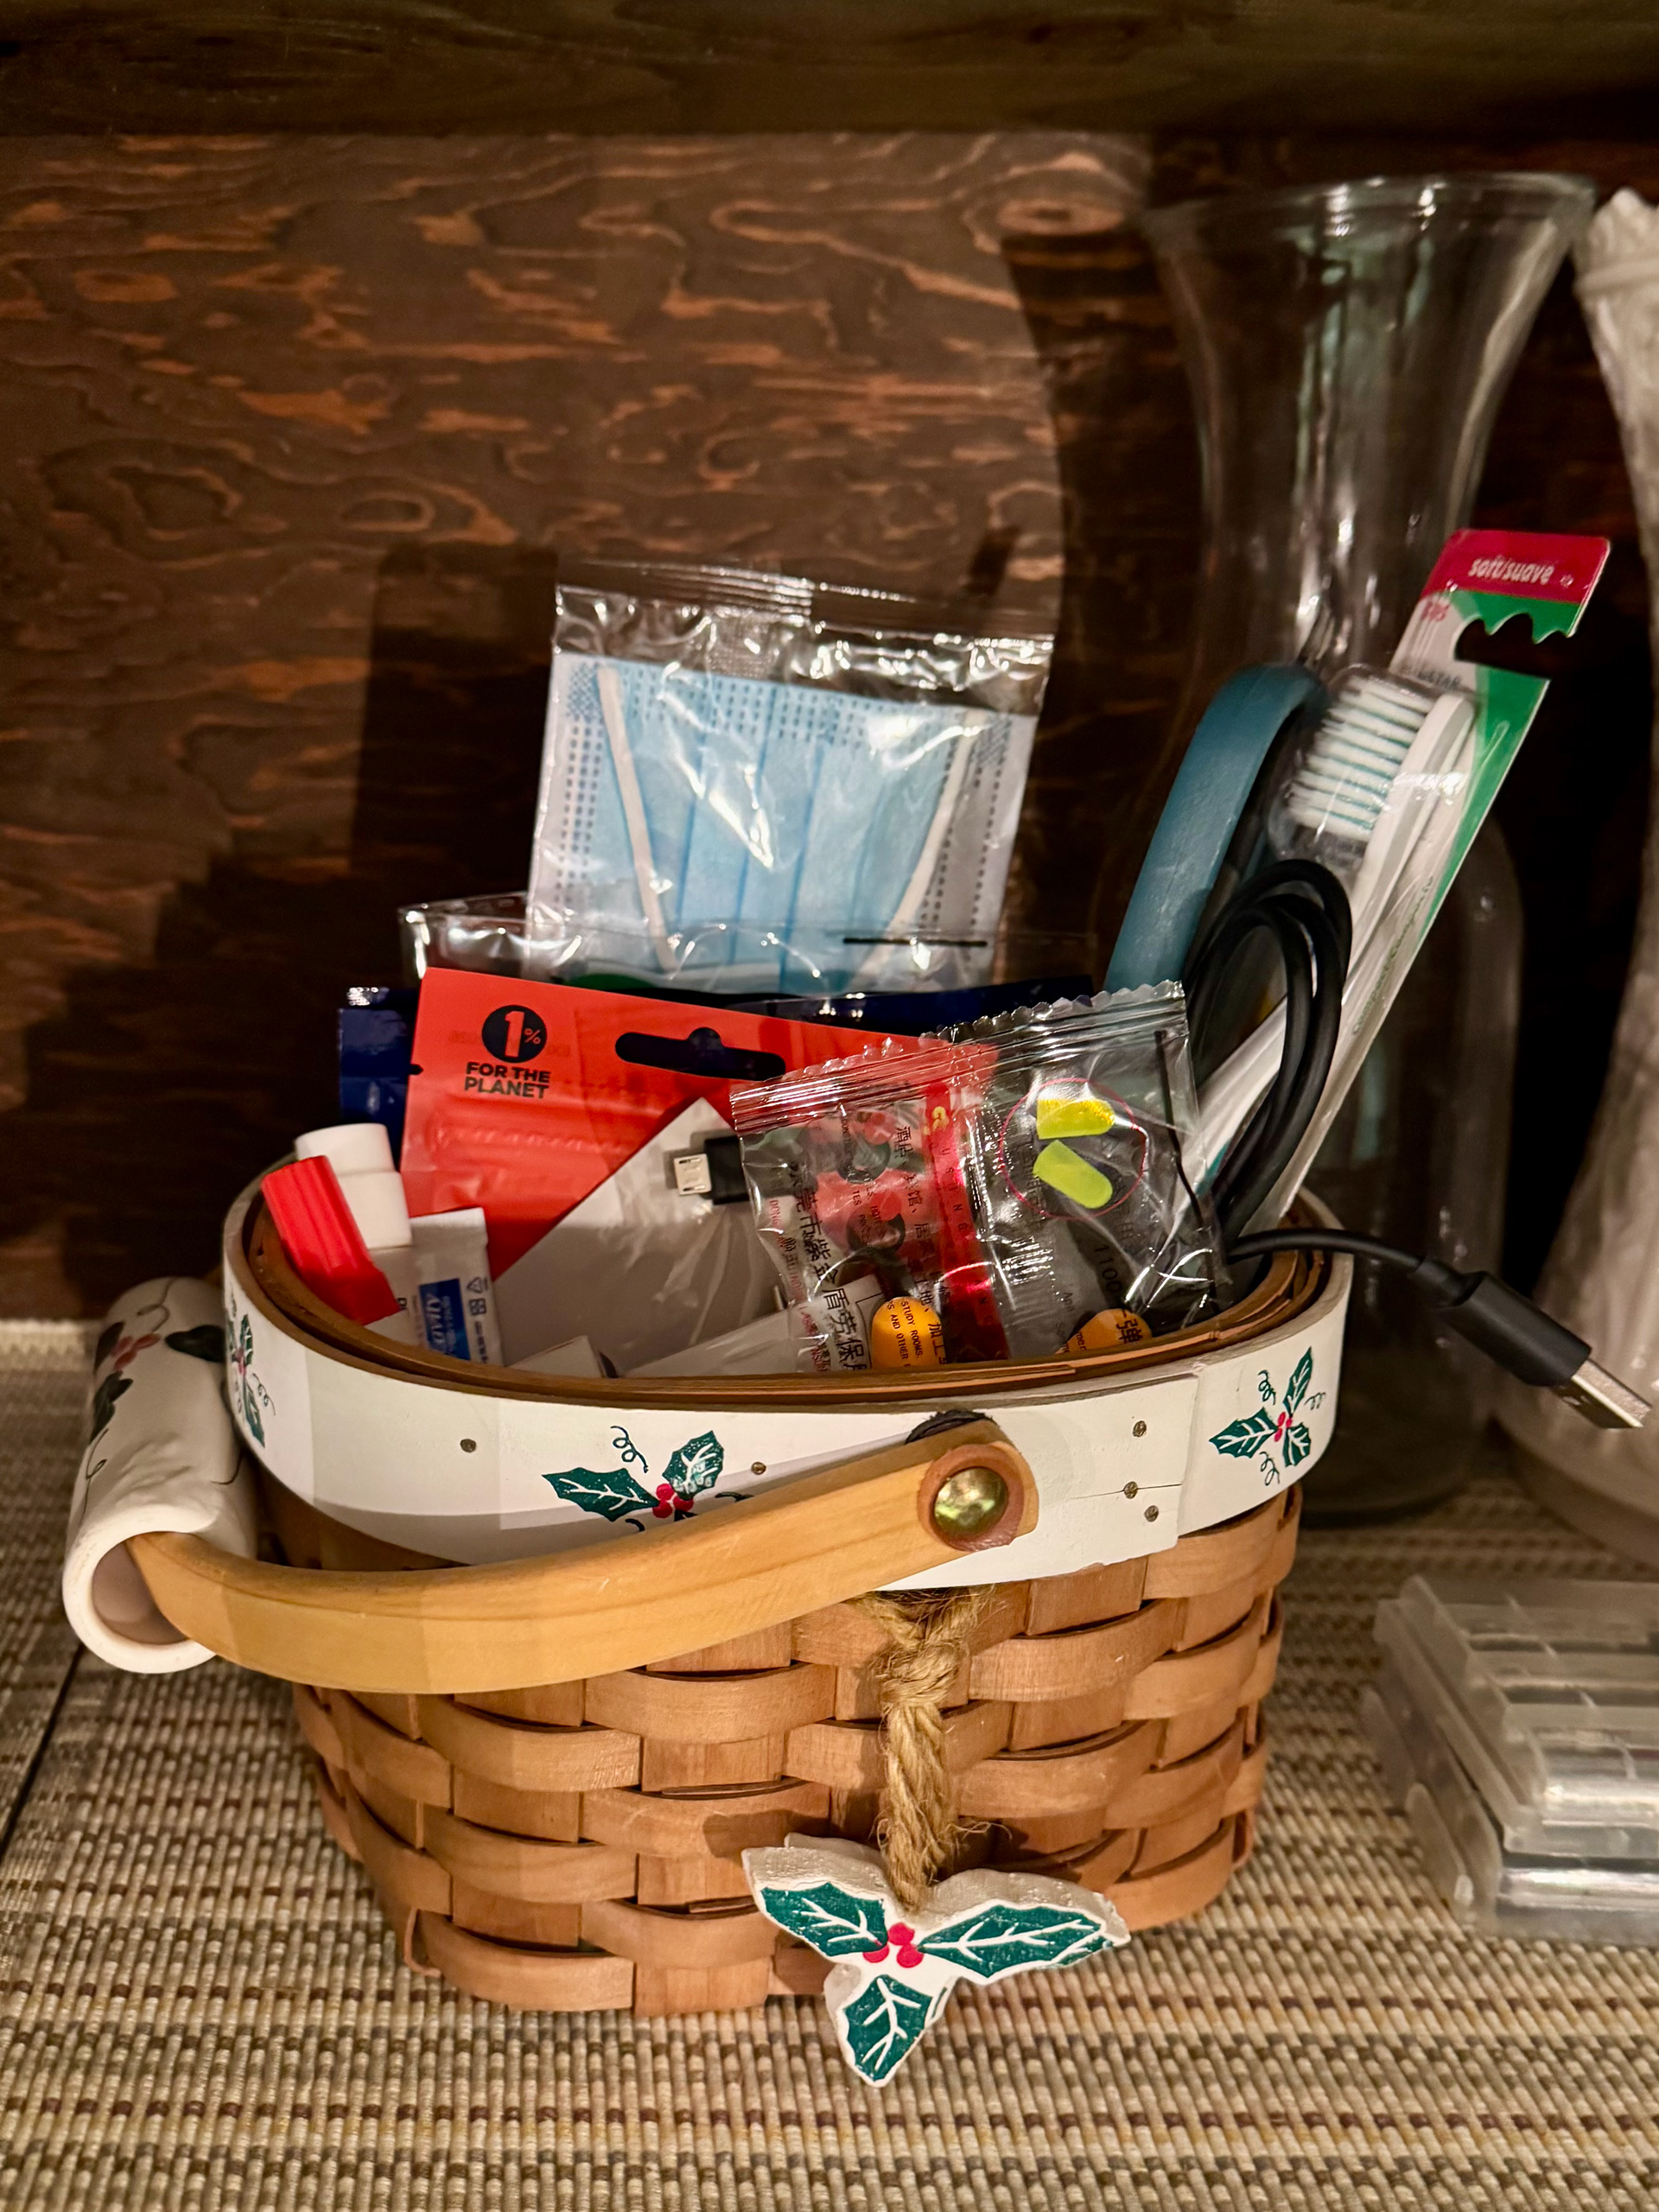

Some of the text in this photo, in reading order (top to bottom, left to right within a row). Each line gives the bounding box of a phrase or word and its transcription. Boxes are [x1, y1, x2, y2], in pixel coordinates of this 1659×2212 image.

[505, 1010, 541, 1058] 1%
[464, 1077, 550, 1100] PLANET
[467, 1061, 550, 1084] FOR THE
[1094, 1245, 1122, 1293] 1100
[900, 1300, 916, 1326] STUDY
[890, 1313, 901, 1331] AND
[896, 1332, 910, 1360] OTHER
